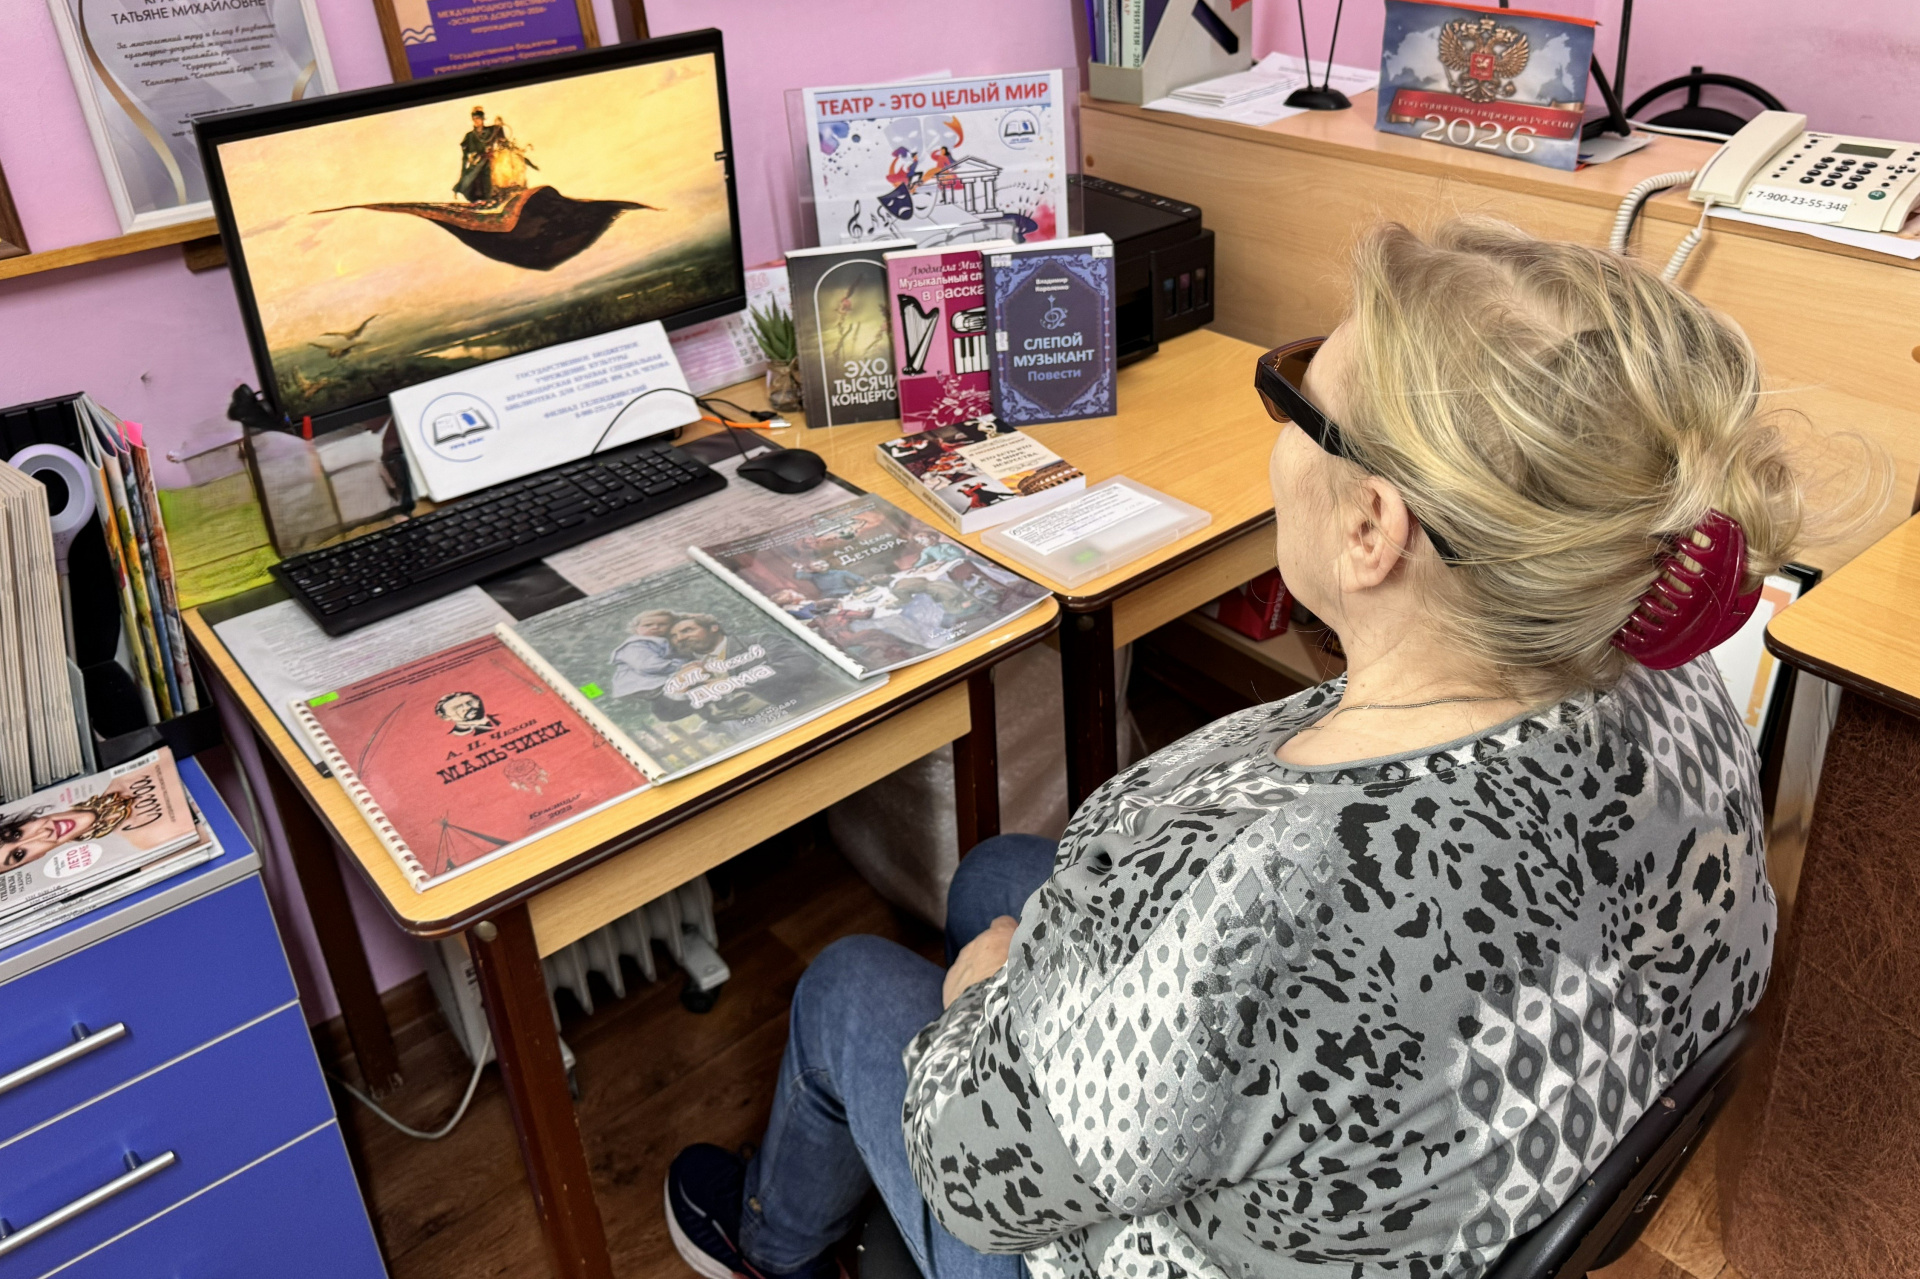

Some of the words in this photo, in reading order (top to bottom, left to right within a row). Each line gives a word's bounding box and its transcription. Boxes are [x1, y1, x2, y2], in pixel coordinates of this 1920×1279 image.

[111, 7, 169, 25] ТАТЬЯНЕ
[172, 0, 266, 18] МИХАЙЛОВНЕ
[437, 1, 514, 18] МЕЖДУНАРОДНОГО
[817, 97, 874, 116] ТЕАТР
[890, 92, 926, 110] ЭТО
[932, 82, 999, 109] ЦЕЛЫЙ
[1005, 82, 1048, 100] МИР
[1529, 114, 1576, 129] России
[1420, 113, 1537, 154] 2026
[1755, 190, 1848, 212] 7-900-23-55-348
[908, 264, 957, 277] Людмила
[899, 272, 968, 290] Музыкальный
[1035, 277, 1069, 285] Владимир
[922, 291, 930, 300] в
[935, 284, 985, 302] расска
[1023, 331, 1083, 351] СЛЕПОЙ
[588, 354, 628, 369] КУЛЬТУРЫ
[843, 357, 888, 378] ЭХО
[1013, 349, 1095, 368] МУЗЫКАНТ
[1027, 369, 1082, 382] Повести
[559, 387, 575, 397] ДЛЯ
[577, 378, 609, 391] СЛЕПЫХ
[839, 538, 908, 566] ДЕТВОРА
[436, 720, 571, 785] МАЛЬЧИКИ
[446, 751, 463, 761] А.
[467, 740, 486, 751] П.
[66, 849, 81, 870] ЛЕТО
